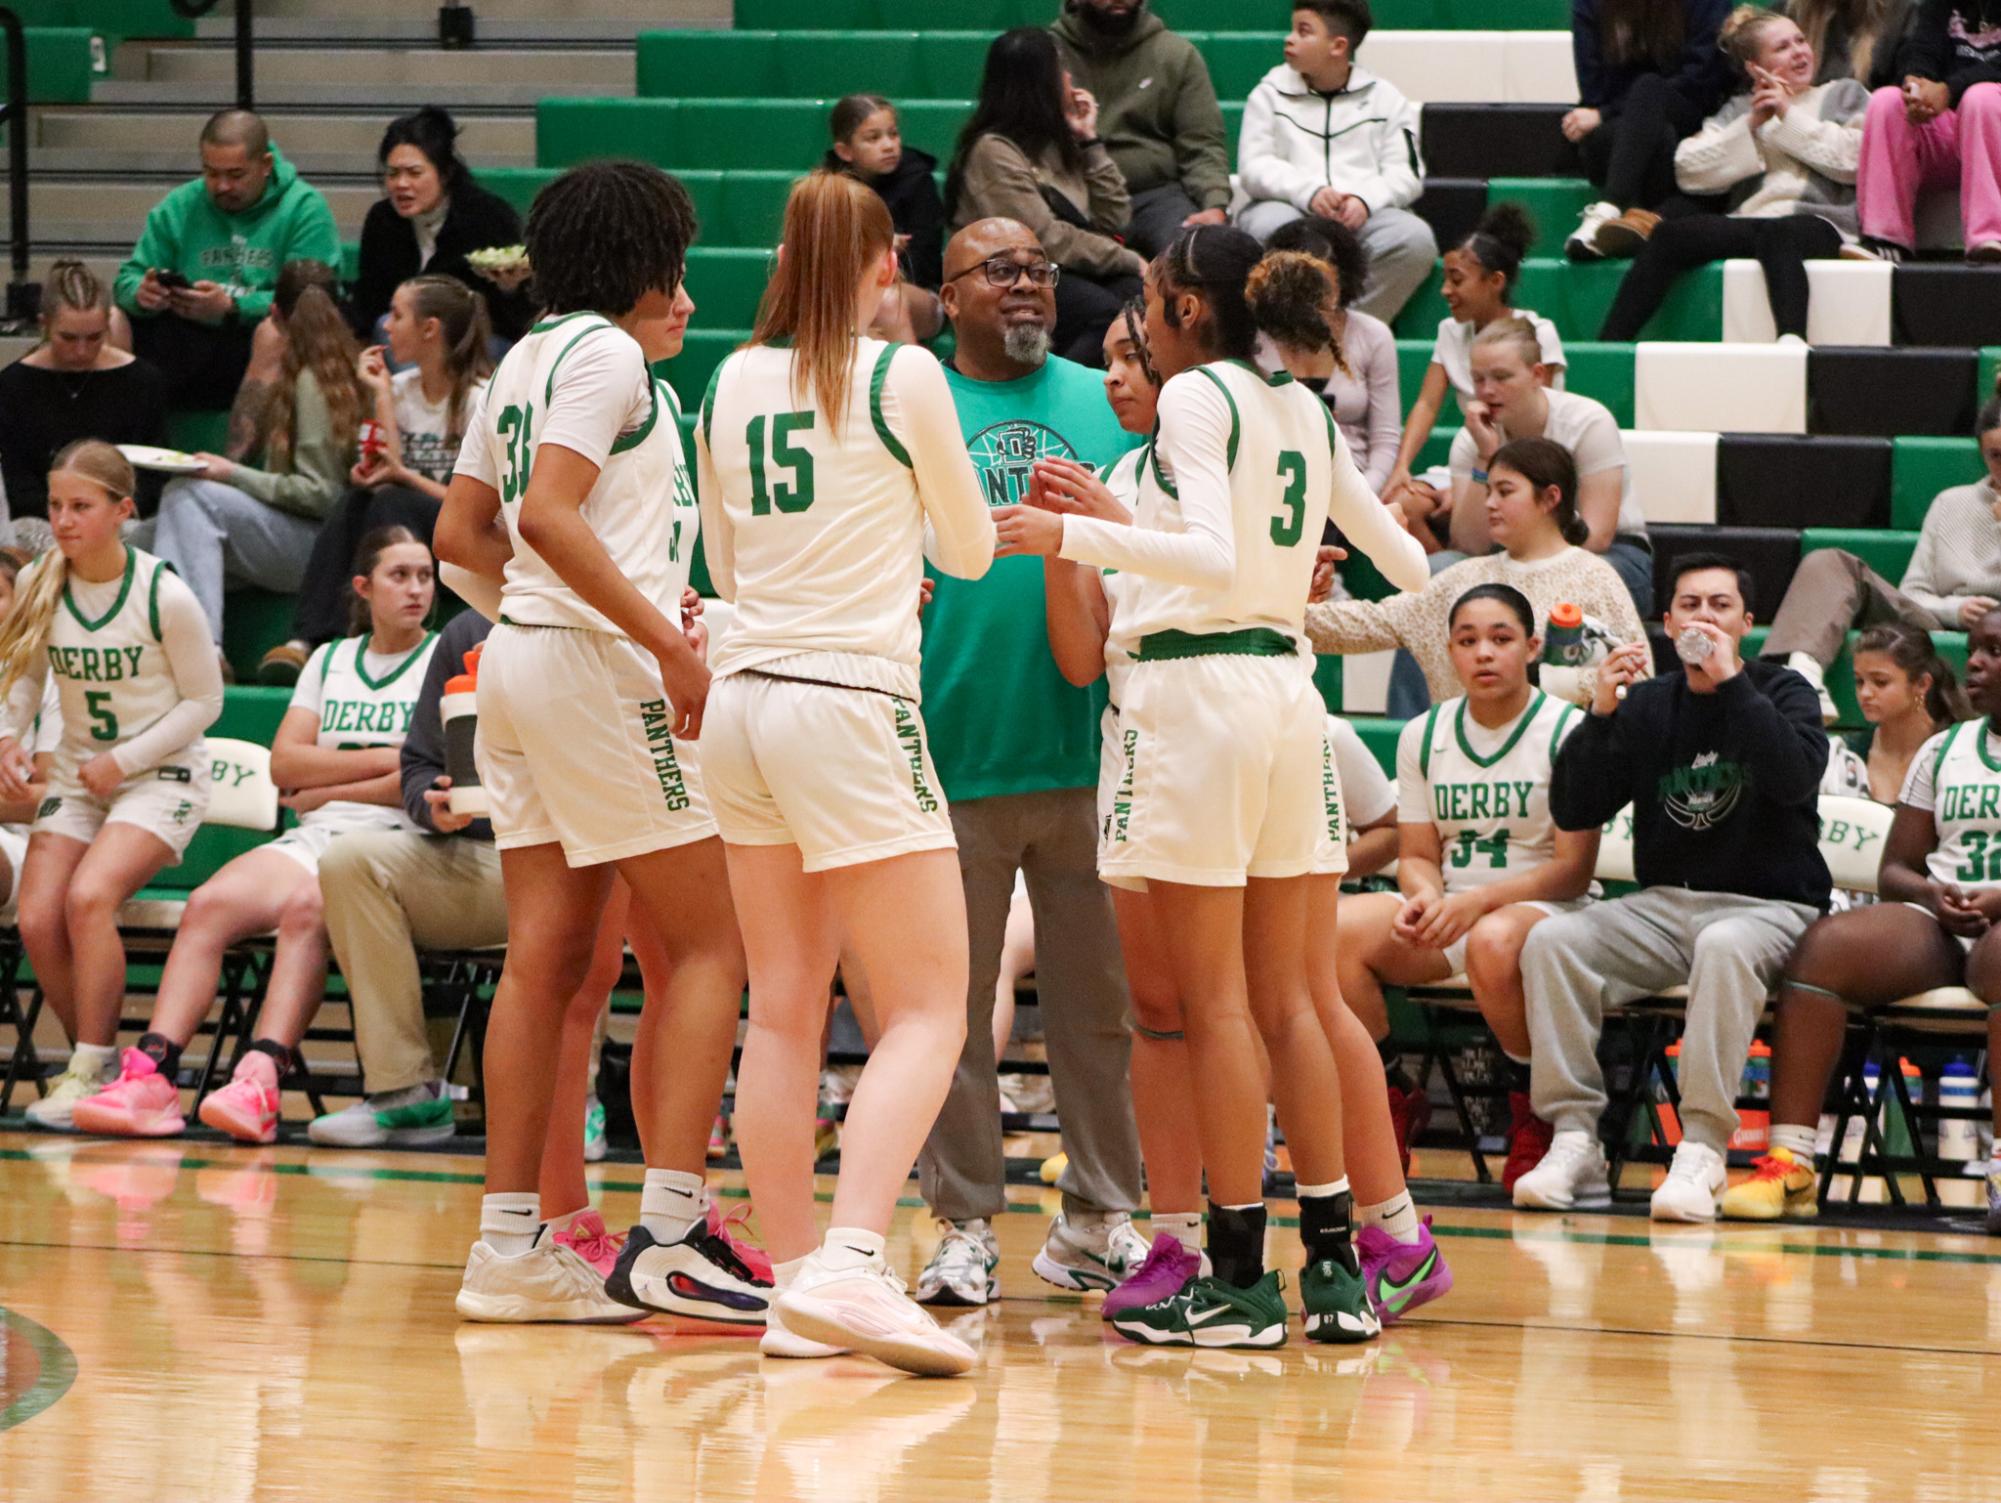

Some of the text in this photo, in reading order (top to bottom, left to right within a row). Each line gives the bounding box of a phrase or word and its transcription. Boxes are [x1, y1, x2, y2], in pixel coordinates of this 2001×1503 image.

[745, 410, 815, 516] 15
[1270, 450, 1306, 548] 3
[47, 645, 143, 682] DERBY
[85, 691, 119, 741] 5
[321, 700, 419, 733] DERBY
[640, 698, 690, 812] PANTHERS
[1323, 734, 1342, 843] PANTHER
[1434, 782, 1534, 820] DERBY
